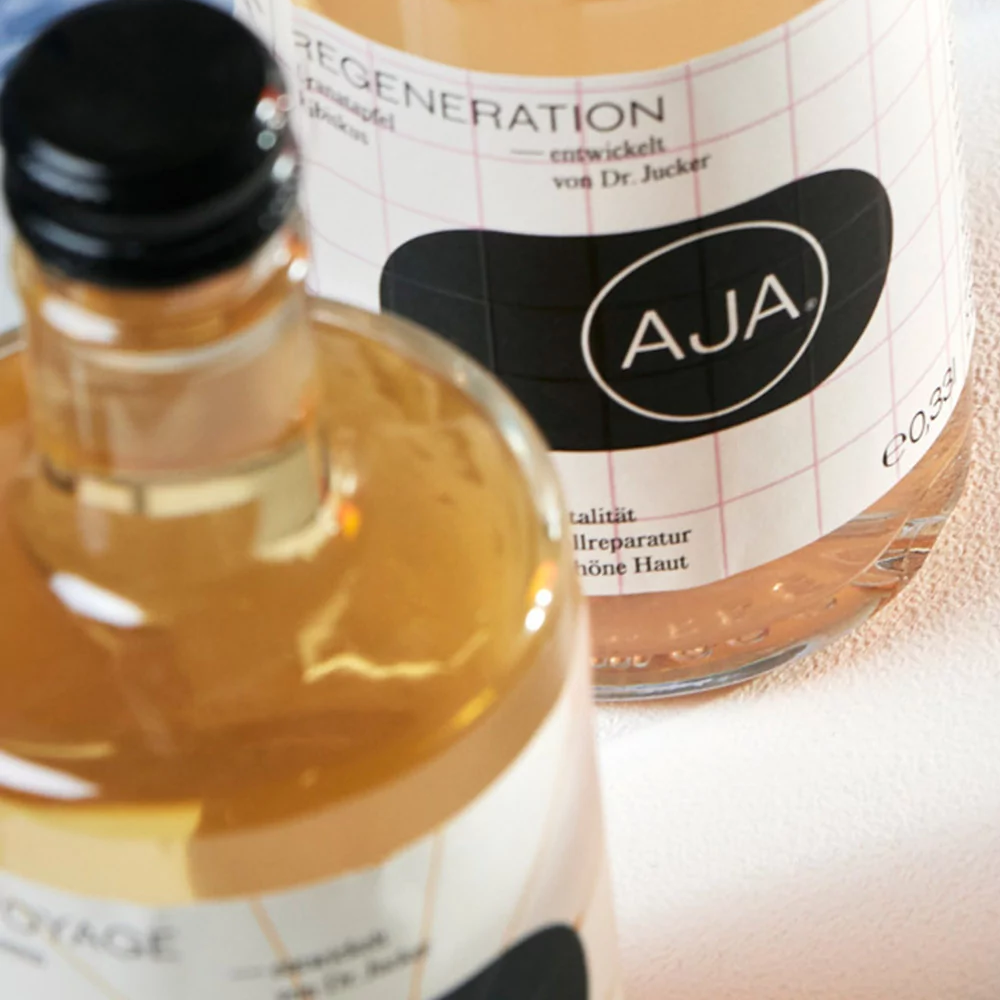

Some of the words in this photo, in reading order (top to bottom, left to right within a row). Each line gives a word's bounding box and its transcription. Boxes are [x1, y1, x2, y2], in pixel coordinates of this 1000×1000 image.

[292, 30, 665, 133] REGENERATION
[550, 136, 666, 163] entwickelt
[553, 174, 593, 190] von
[641, 153, 711, 183] Jucker
[569, 507, 637, 525] talität
[573, 529, 692, 553] llreparatur
[574, 559, 627, 577] höne
[634, 555, 689, 575] Haut
[2, 897, 181, 965] OYAGE
